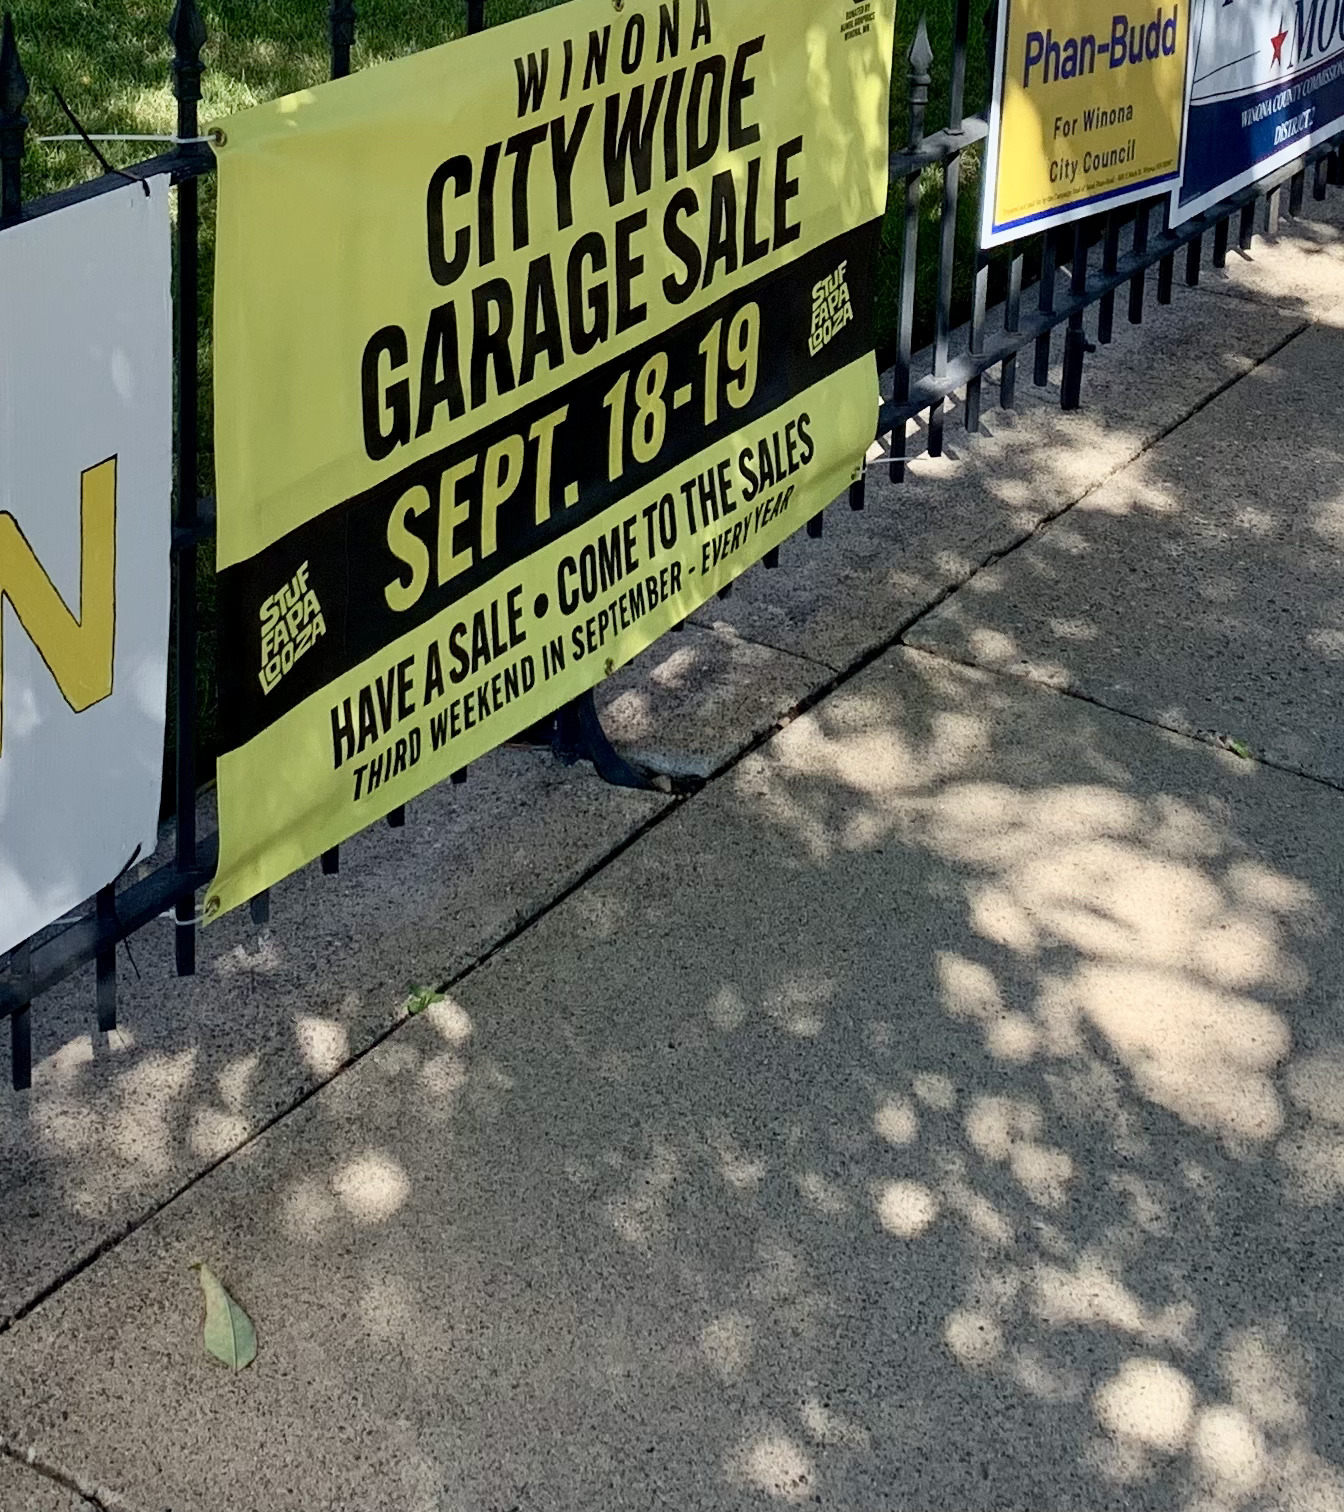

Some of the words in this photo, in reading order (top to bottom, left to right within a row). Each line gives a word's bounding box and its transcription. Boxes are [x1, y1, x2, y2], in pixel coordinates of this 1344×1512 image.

[1023, 3, 1178, 88] Phan-Budd
[1053, 113, 1078, 140] For
[1083, 103, 1133, 131] Winona
[1241, 97, 1272, 128] WINONA
[1272, 83, 1304, 115] COUNTY
[1274, 108, 1311, 146] DISTRICT
[1049, 156, 1079, 184] City
[1083, 139, 1136, 174] Council
[361, 208, 648, 462] GARAGE
[662, 134, 804, 305] SALE
[811, 282, 850, 336] FAPA
[812, 259, 847, 312] STUF
[384, 404, 580, 612] SEPT.
[603, 301, 760, 482] 18-19
[259, 560, 309, 638] STUF
[261, 589, 321, 668] FAPA
[330, 654, 415, 770] HAVE
[423, 640, 444, 707] A
[448, 584, 526, 684] SALE
[557, 514, 639, 616] COME
[643, 493, 677, 560] TO
[680, 458, 737, 535] THE
[738, 412, 814, 502] SALES
[258, 612, 327, 696] LOOZA
[352, 727, 422, 802] THIRD
[429, 655, 535, 752] WEEKEND
[542, 635, 566, 681] IN
[572, 560, 682, 662] SEPTEMBER
[701, 512, 752, 576] EVERY
[755, 484, 795, 534] YEAR
